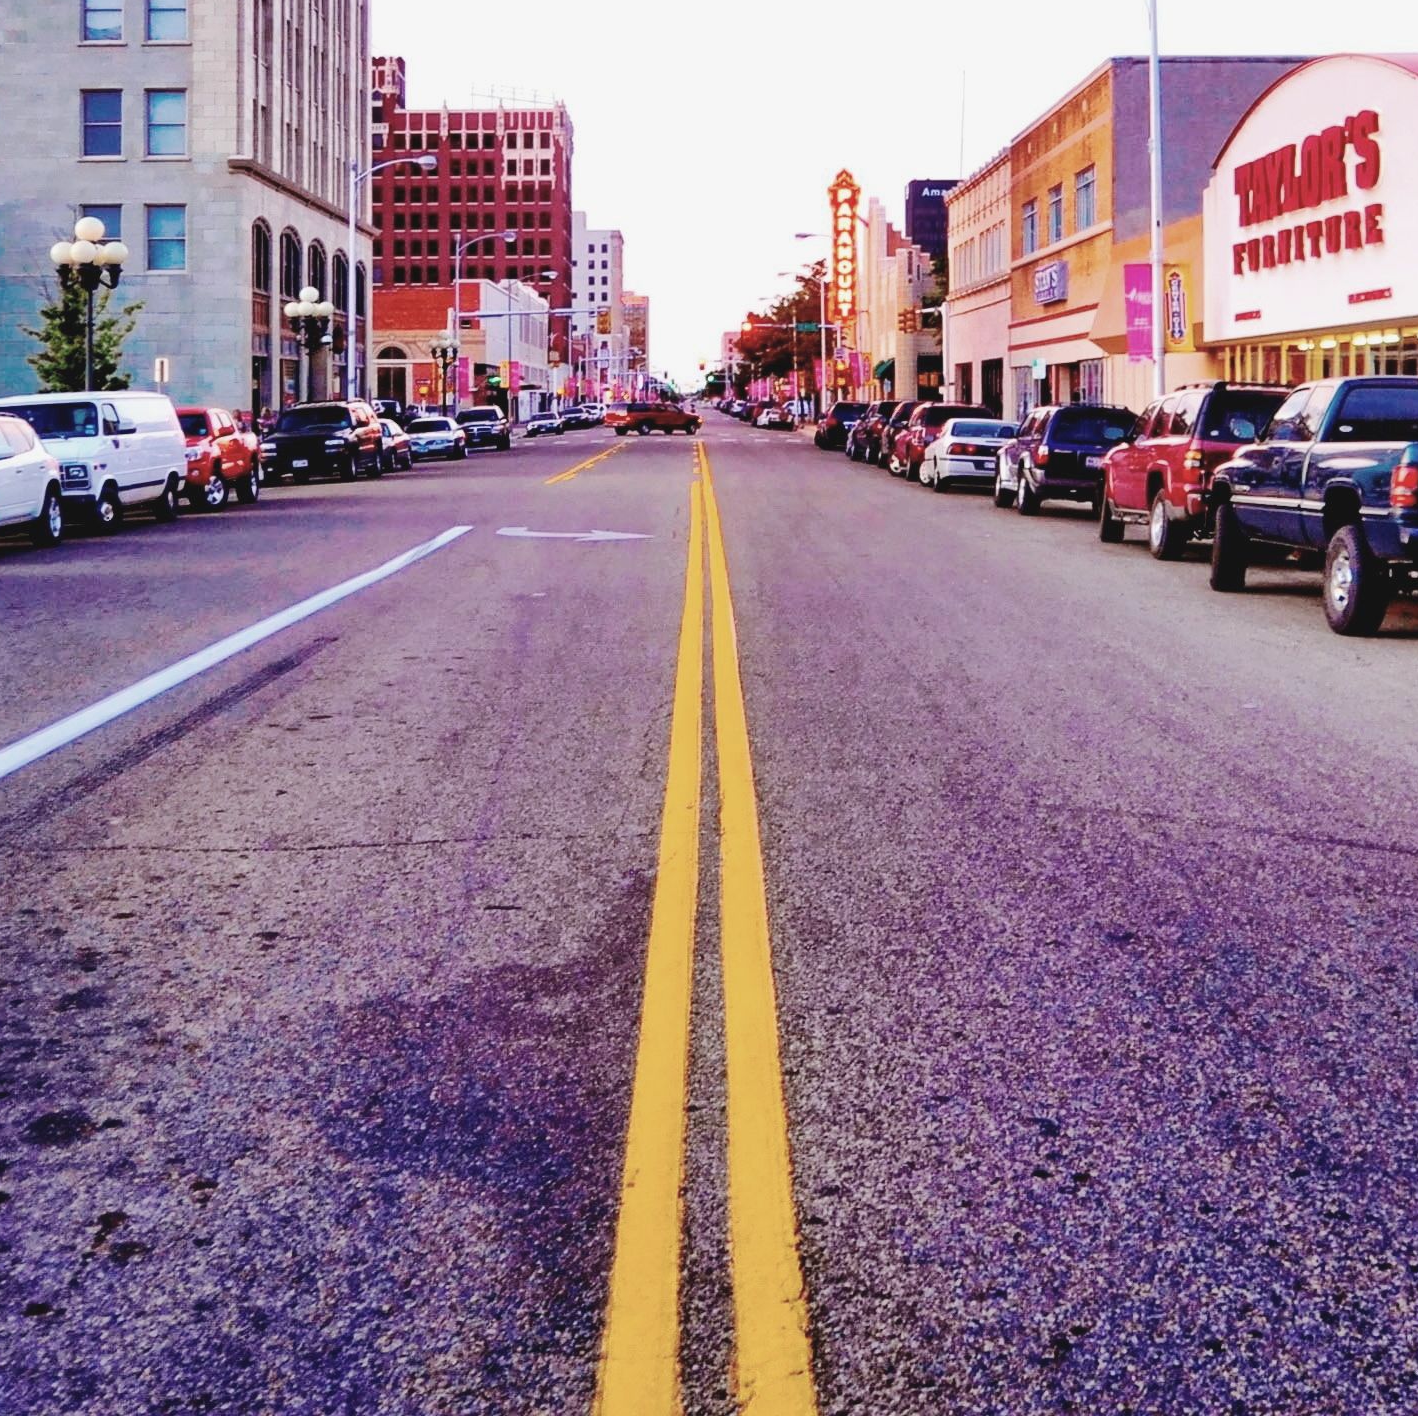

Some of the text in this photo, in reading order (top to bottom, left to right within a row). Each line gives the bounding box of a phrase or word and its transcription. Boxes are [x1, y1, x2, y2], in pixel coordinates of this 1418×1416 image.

[1234, 110, 1381, 228] TAYLOR'S
[836, 187, 853, 317] PARAMOUNT
[1232, 203, 1384, 276] FURNITURE
